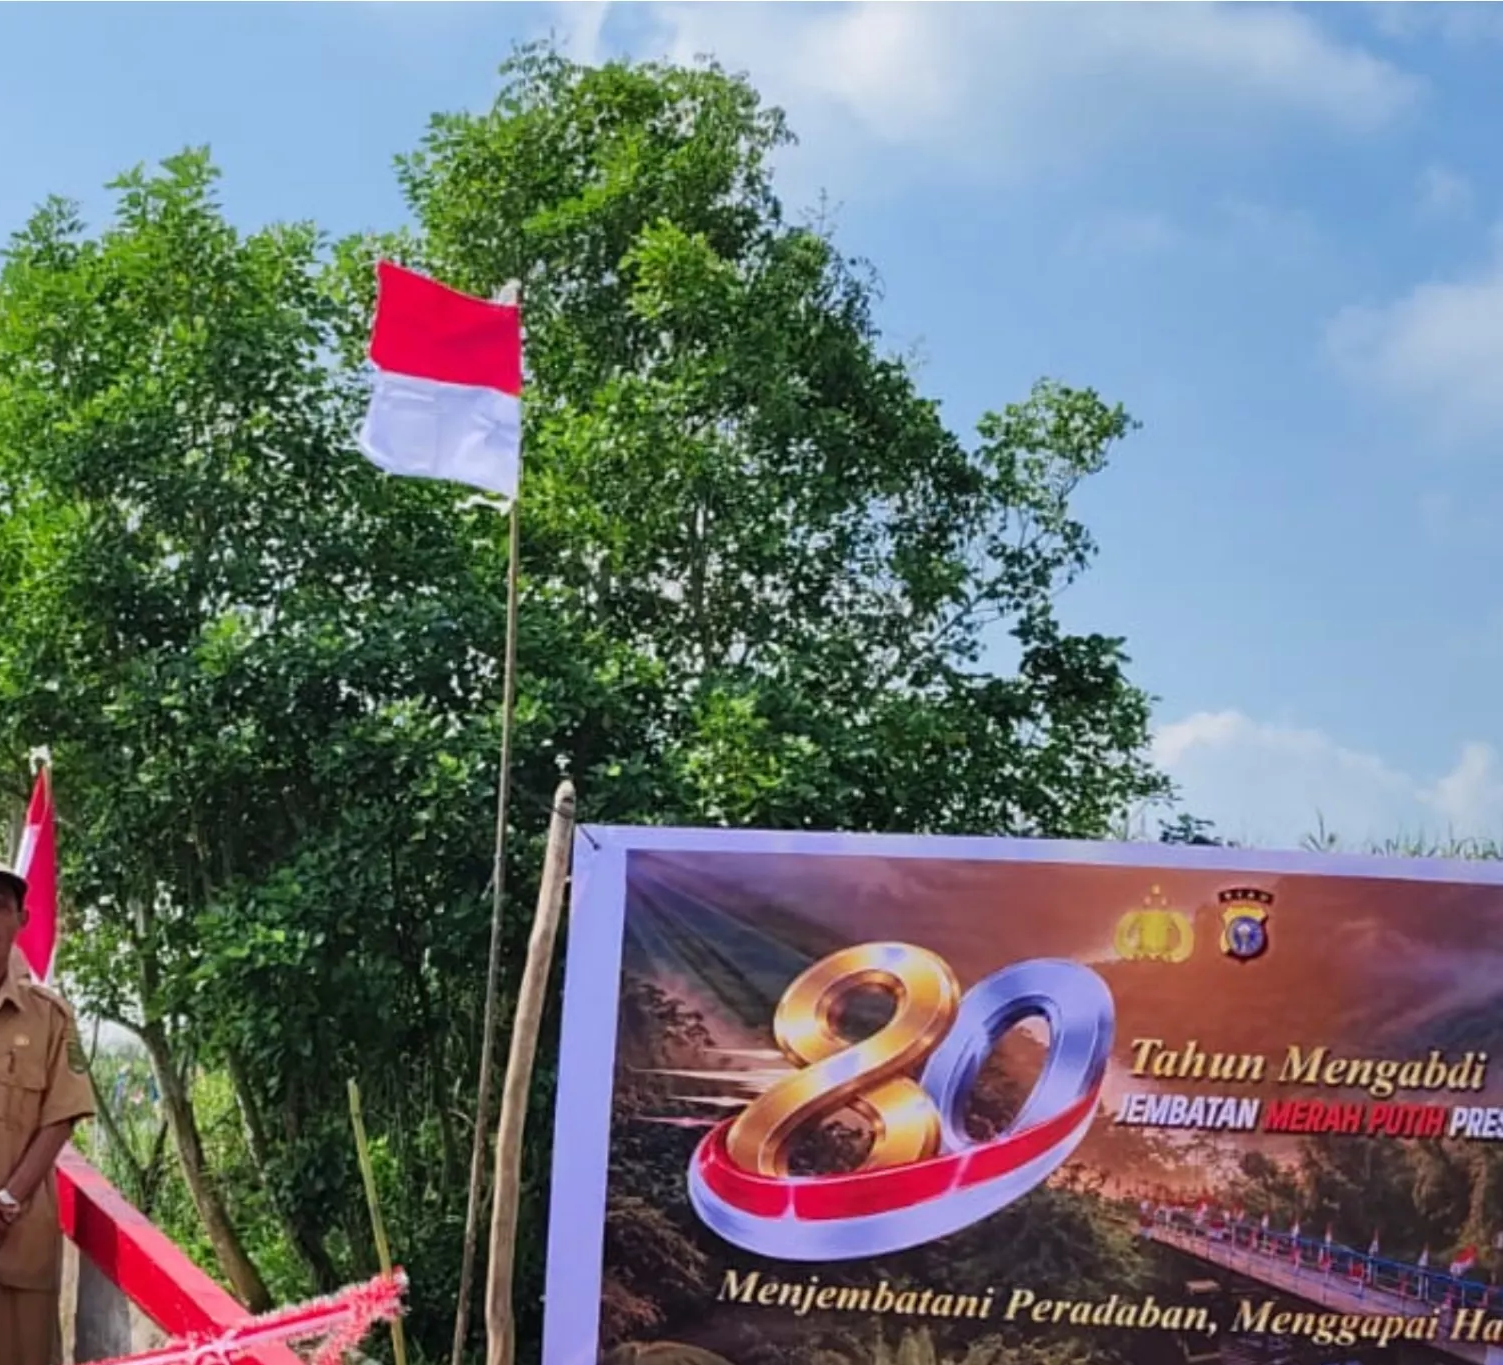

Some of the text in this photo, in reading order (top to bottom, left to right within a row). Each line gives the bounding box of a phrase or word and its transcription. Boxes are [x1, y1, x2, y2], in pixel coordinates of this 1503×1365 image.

[725, 940, 1115, 1180] 80
[1129, 1038, 1488, 1097] Tahun Mengabdi
[1113, 1092, 1260, 1130] JEMBATAN
[1263, 1101, 1362, 1133] MERAH
[1366, 1103, 1447, 1135] PUTIH
[716, 1268, 1503, 1348] Menjembatani Peradaban, Menggapai Ha
